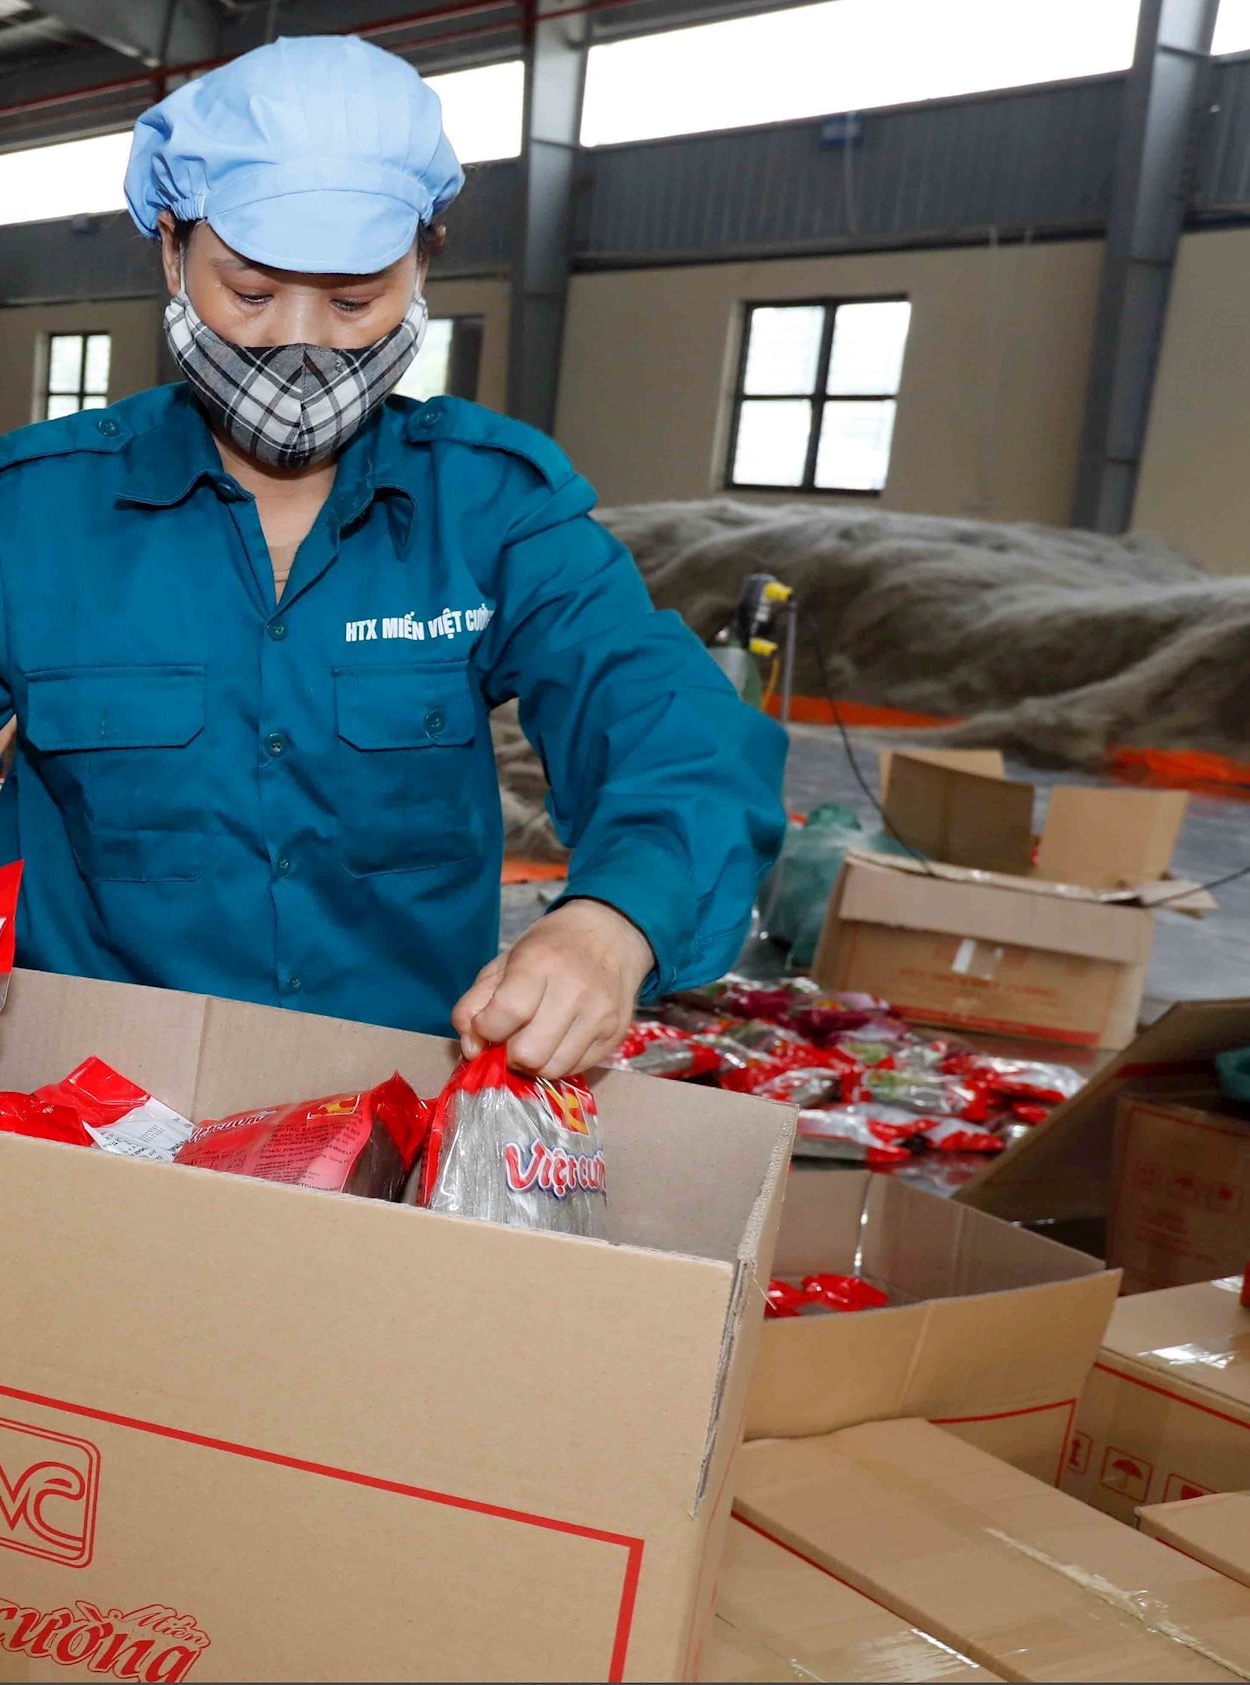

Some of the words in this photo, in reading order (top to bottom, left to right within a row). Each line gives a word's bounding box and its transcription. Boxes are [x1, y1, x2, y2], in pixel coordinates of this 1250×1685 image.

[345, 618, 378, 642] HTX
[382, 611, 425, 641] MIẾN
[428, 607, 463, 640] VIỆT
[505, 1138, 578, 1198] Việt
